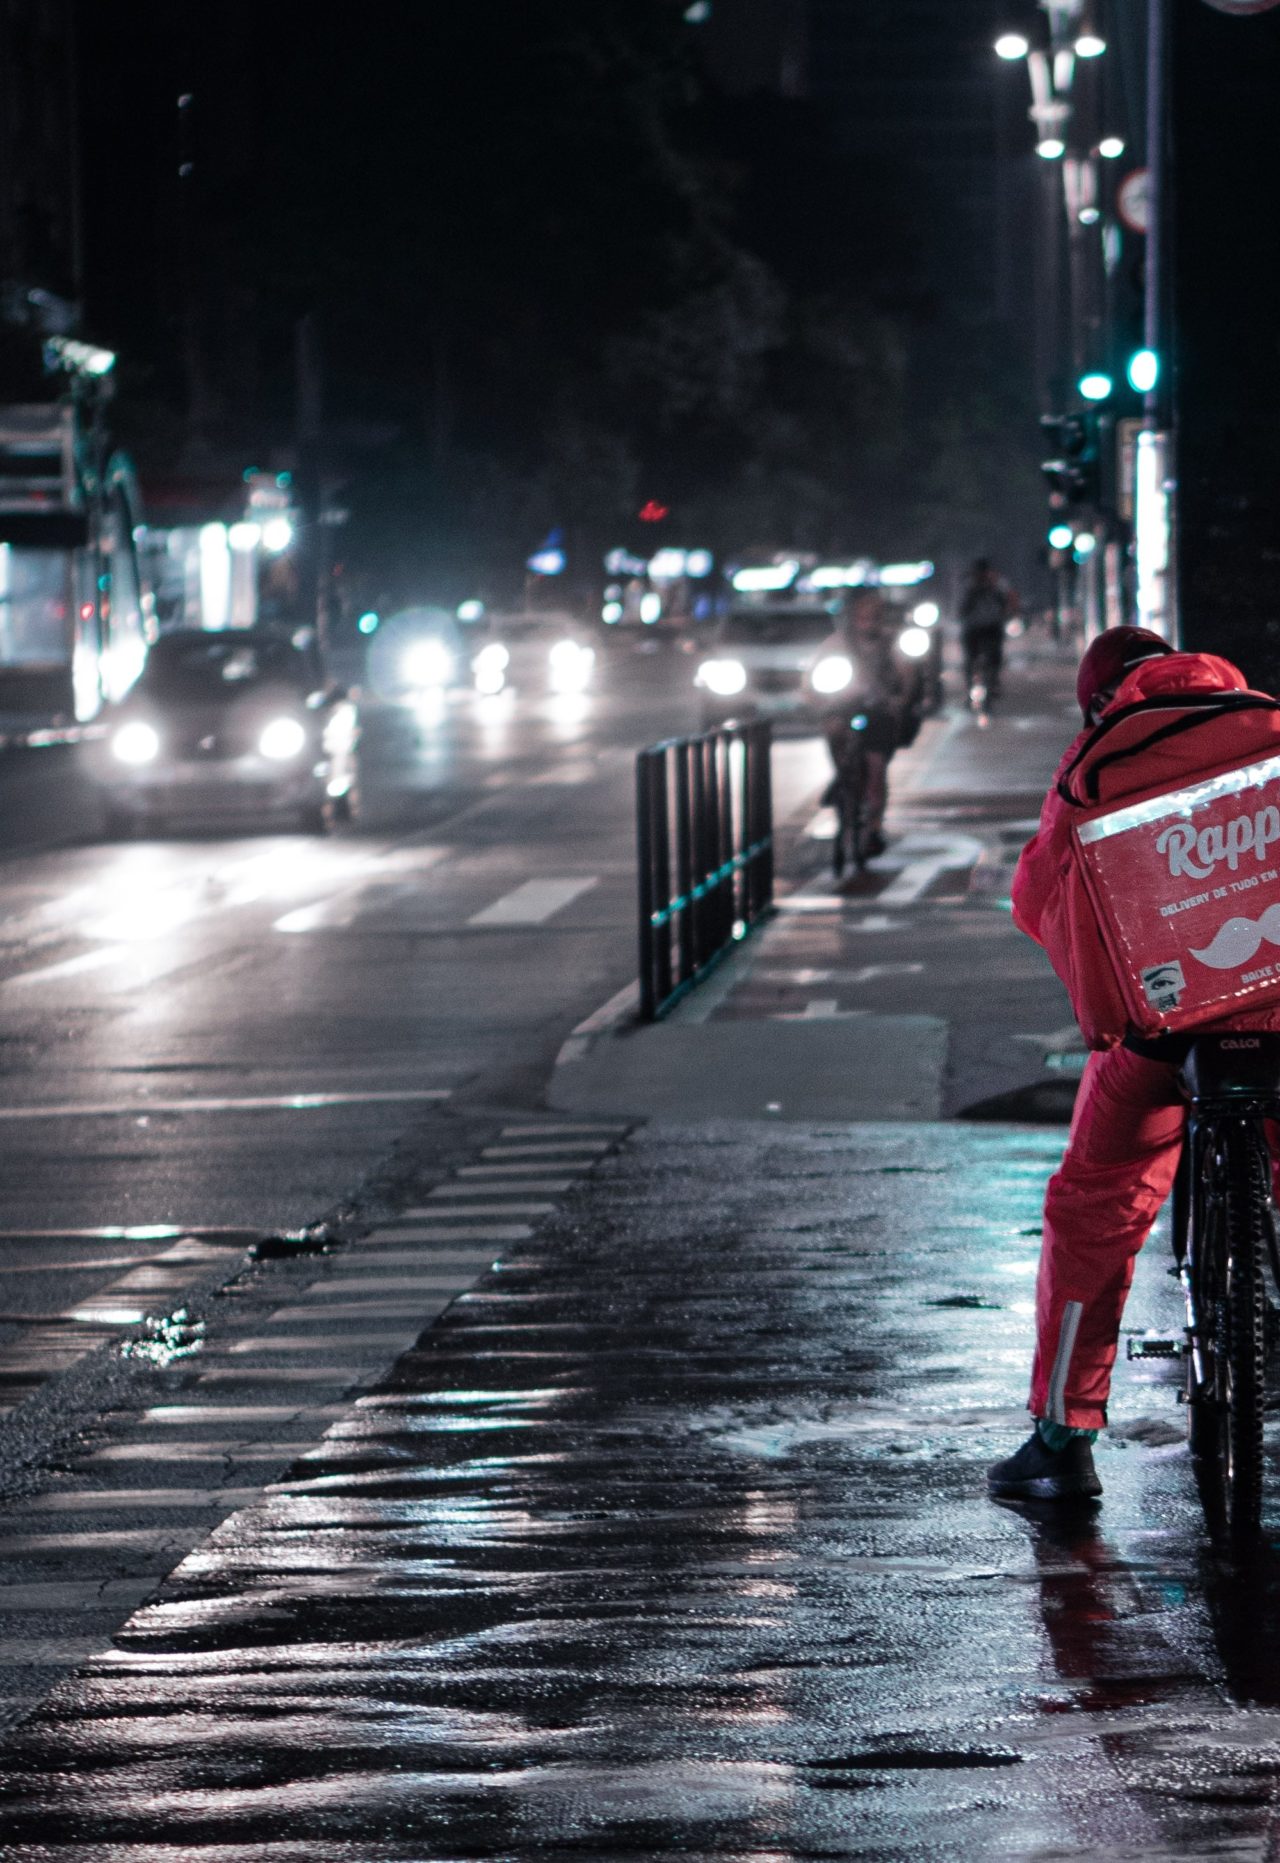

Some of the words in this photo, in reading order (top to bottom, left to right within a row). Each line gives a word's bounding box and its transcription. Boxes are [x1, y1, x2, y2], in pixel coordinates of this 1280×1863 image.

[1159, 892, 1210, 917] DELIVERY
[1212, 887, 1228, 899] DE
[1229, 876, 1259, 892] TUDO
[1261, 870, 1278, 883] EM
[1241, 966, 1274, 984] BAIXE
